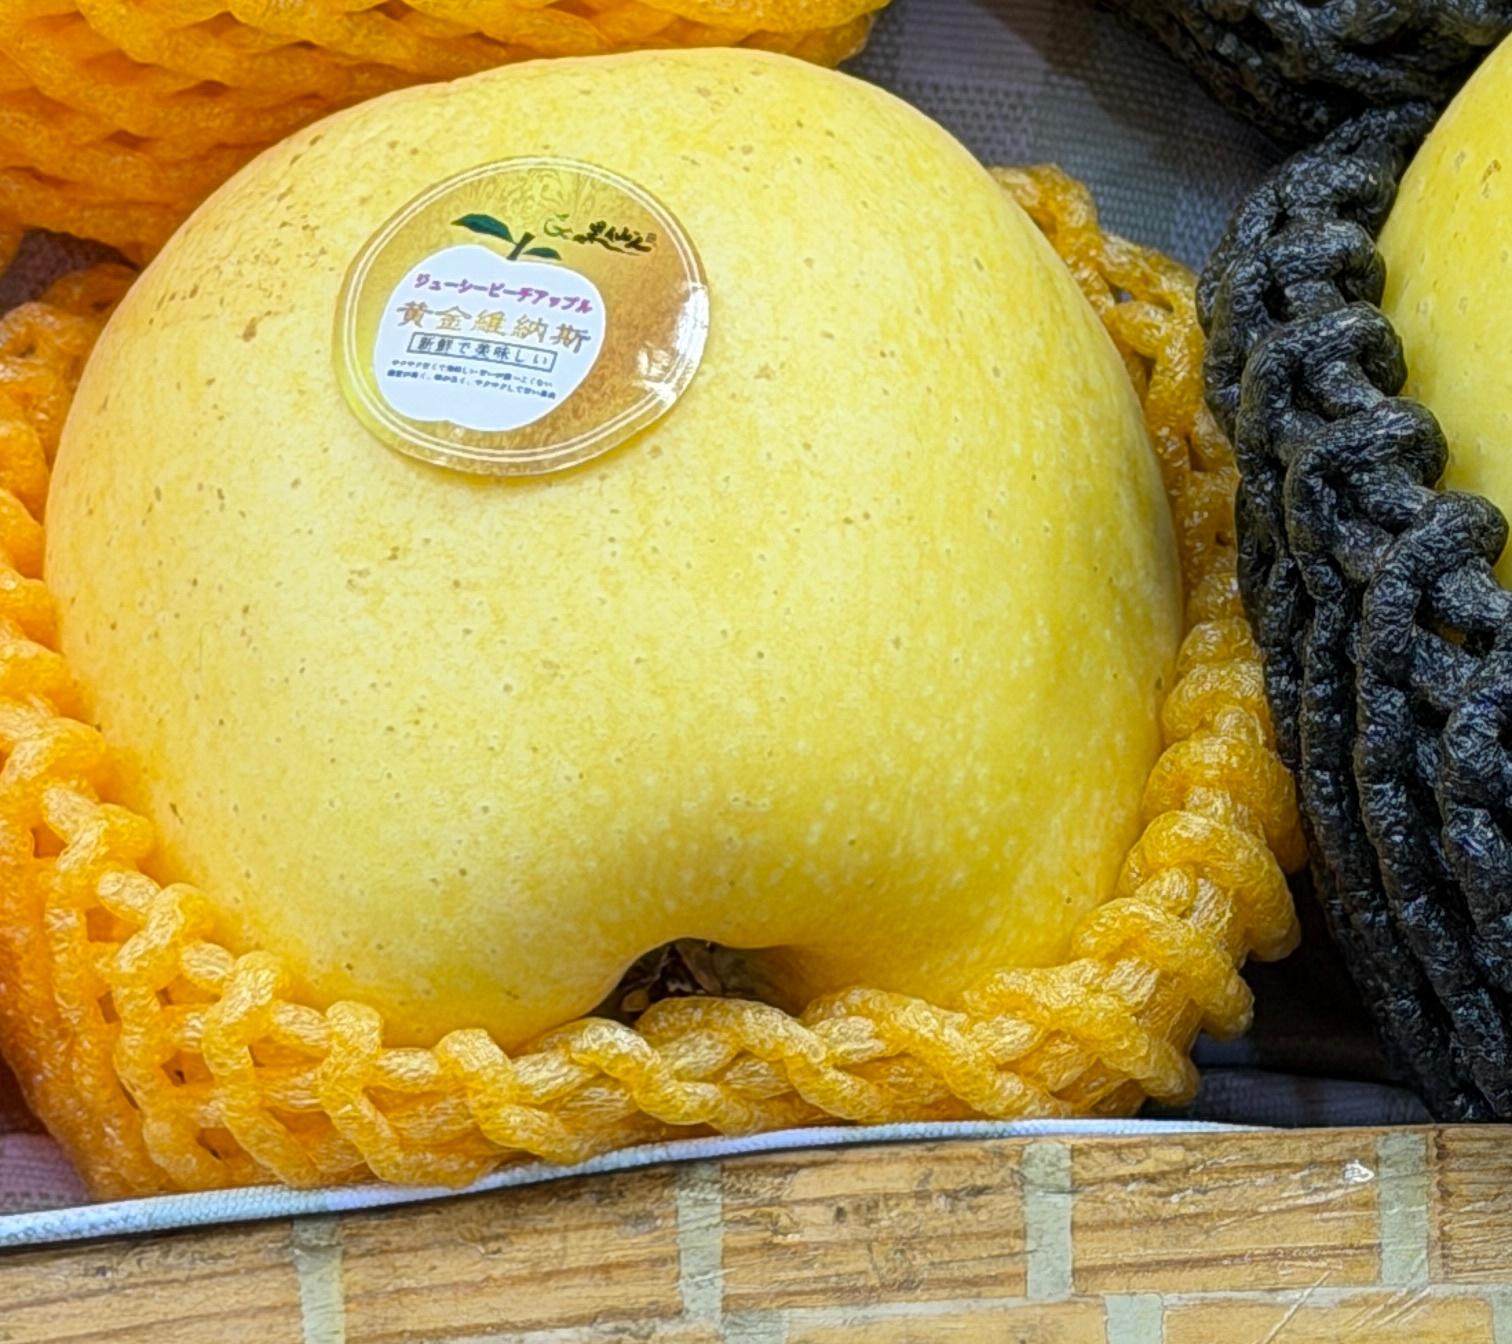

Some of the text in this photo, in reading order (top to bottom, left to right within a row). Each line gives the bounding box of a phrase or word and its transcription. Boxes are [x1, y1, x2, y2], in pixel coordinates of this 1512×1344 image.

[397, 301, 591, 353] 黄金維納斯
[417, 336, 548, 366] 新鮮で美味しい
